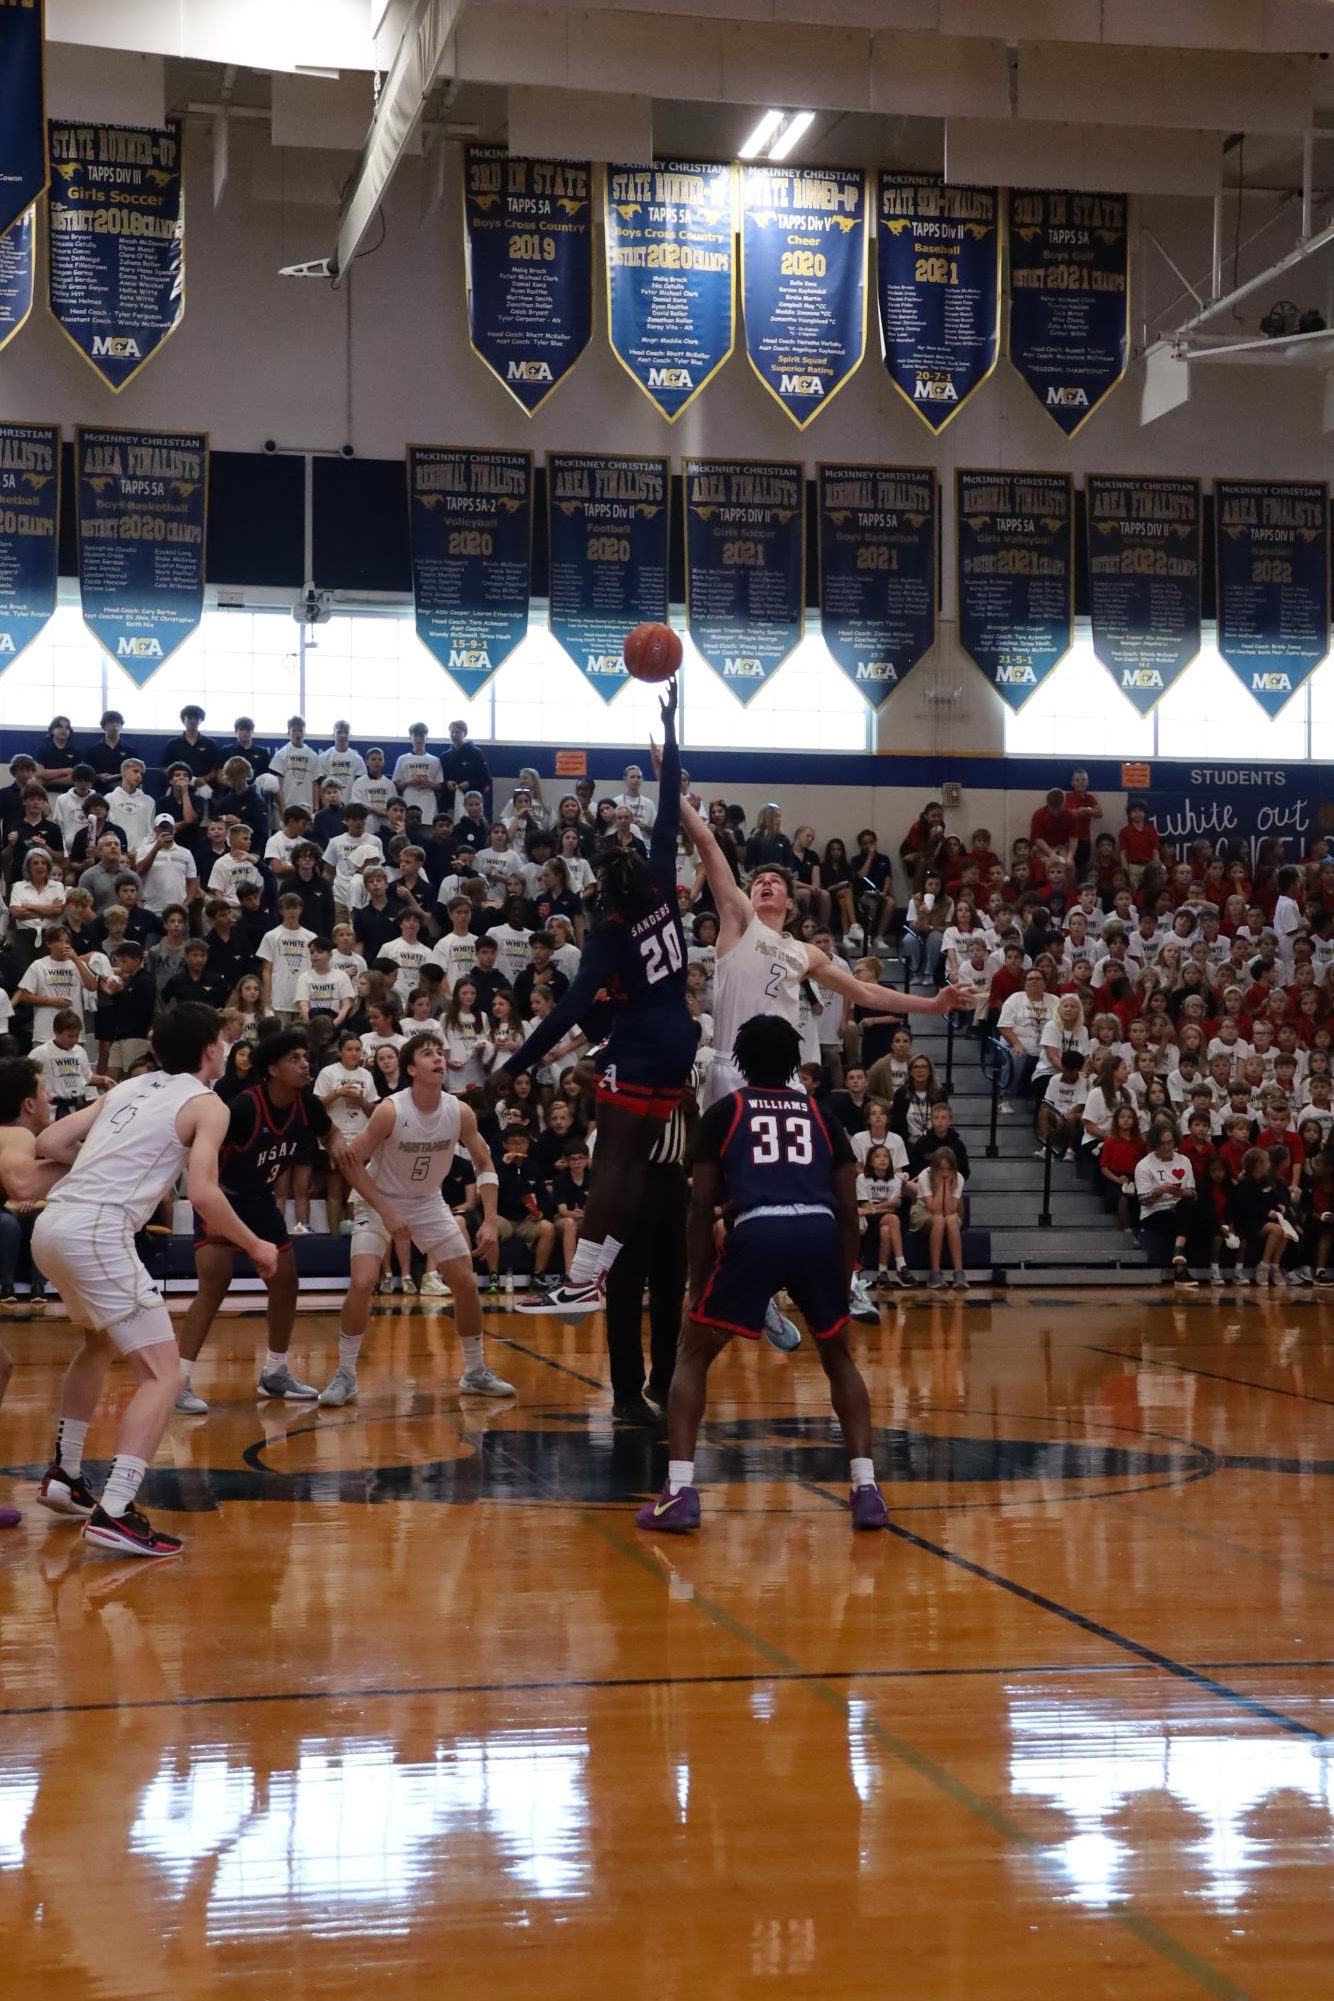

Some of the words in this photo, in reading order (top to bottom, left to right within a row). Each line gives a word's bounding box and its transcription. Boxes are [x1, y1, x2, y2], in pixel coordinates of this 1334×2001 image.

[53, 129, 95, 160] STATE
[88, 165, 114, 182] TAPPS
[115, 168, 132, 183] DIV
[133, 169, 141, 184] III
[533, 163, 586, 197] STATE
[749, 166, 802, 179] McKINNEY
[804, 169, 861, 182] CHRISTIAN
[883, 173, 936, 186] McKINNEY
[67, 186, 106, 202] Girls
[109, 191, 166, 206] Soccer
[613, 173, 652, 202] STATE
[793, 178, 859, 212] RUNNER-UP
[507, 197, 536, 213] TAPPS
[538, 200, 551, 214] 5A
[648, 206, 677, 223] TAPPS
[679, 211, 692, 223] 5A
[1072, 195, 1123, 229] STATE
[473, 217, 502, 230] Boys
[504, 218, 537, 230] Cross
[539, 221, 586, 235] Country
[778, 213, 806, 230] TAPPS
[807, 215, 823, 231] Div
[824, 216, 832, 231] V
[912, 221, 940, 238] TAPPS
[941, 223, 957, 240] Div
[958, 224, 964, 239] II
[615, 226, 642, 239] Boys
[644, 228, 676, 239] Cross
[679, 230, 724, 243] Country
[787, 235, 821, 246] Cheer
[1048, 229, 1077, 244] TAPPS
[1077, 230, 1089, 244] 5A
[508, 234, 556, 261] 2019
[647, 243, 692, 269] 2020
[915, 242, 960, 255] Baseball
[781, 250, 827, 277] 2020
[915, 257, 959, 285] 2021
[1047, 264, 1090, 290] 2021
[91, 336, 141, 358] MCA
[778, 355, 801, 365] Spirit
[802, 356, 828, 366] Squad
[507, 361, 554, 381] MCA
[648, 368, 693, 388] MCA
[771, 364, 805, 374] Superior
[807, 366, 834, 376] Rating
[916, 370, 953, 381] 20-7-1
[780, 374, 825, 395] MCA
[914, 380, 959, 400] MCA
[1046, 386, 1089, 406] MCA
[85, 433, 138, 445] McKINNEY
[141, 437, 200, 449] CHRISTIAN
[84, 447, 123, 476] AREA
[127, 446, 201, 480] FINALISTS
[415, 452, 468, 463] McKINNEY
[470, 454, 526, 465] CHRISTIAN
[554, 459, 606, 470] McKINNEY
[608, 461, 662, 472] CHRISTIAN
[743, 465, 797, 477] CHRISTIAN
[825, 469, 874, 480] McKINNEY
[876, 471, 929, 481] CHRISTIAN
[3, 474, 16, 489] 5A
[120, 479, 150, 495] TAPPS
[152, 481, 165, 496] 5A
[555, 469, 590, 498] AREA
[692, 475, 727, 502] AREA
[962, 475, 1011, 486] McKINNEY
[1013, 477, 1066, 488] CHRISTIAN
[1092, 480, 1141, 491] McKINNEY
[1143, 482, 1195, 492] CHRISTIAN
[1271, 487, 1321, 497] CHRISTIAN
[446, 496, 474, 511] TAPPS
[475, 499, 497, 513] 5A-2
[584, 503, 611, 518] TAPPS
[612, 504, 628, 519] Div
[629, 505, 636, 519] II
[1093, 490, 1128, 518] AREA
[444, 516, 498, 528] Volleyball
[720, 507, 746, 522] TAPPS
[747, 508, 764, 523] DIV
[765, 509, 771, 523] II
[858, 512, 885, 527] TAPPS
[885, 514, 897, 528] 5A
[119, 515, 165, 541] 2020
[586, 523, 631, 534] Football
[996, 518, 1022, 533] TAPPS
[1023, 519, 1035, 534] 5A
[1120, 521, 1146, 536] TAPPS
[1147, 522, 1162, 537] DIV
[1163, 523, 1169, 537] II
[448, 531, 493, 556] 2020
[1250, 528, 1273, 542] TAPPS
[1274, 529, 1289, 543] DIV
[586, 537, 631, 562] 2020
[722, 540, 765, 566] 2021
[856, 546, 899, 571] 2021
[998, 548, 1040, 576] 2021
[1120, 547, 1168, 576] 2022
[1252, 560, 1293, 584] 2022
[117, 636, 164, 656] MCA
[451, 639, 489, 650] 15-9-1
[448, 649, 492, 669] MCA
[723, 658, 765, 676] MCA
[856, 662, 898, 680] MCA
[995, 666, 1037, 683] MCA
[1122, 669, 1164, 687] MCA
[1252, 673, 1293, 690] MCA
[1190, 769, 1288, 787] STUDENTS
[1149, 797, 1238, 837] white
[1257, 799, 1310, 832] out
[631, 902, 671, 938] SANDERS
[281, 939, 305, 948] WHITE
[453, 945, 476, 953] WHITE
[505, 940, 528, 948] WHITE
[640, 919, 683, 985] 20
[399, 953, 424, 962] WHITE
[764, 963, 788, 999] 2
[56, 1058, 80, 1066] WHITE
[748, 1098, 808, 1112] WILLIAMS
[750, 1115, 813, 1165] 33
[266, 1164, 281, 1184] 3
[411, 1157, 431, 1181] 5
[1157, 1170, 1165, 1181] I
